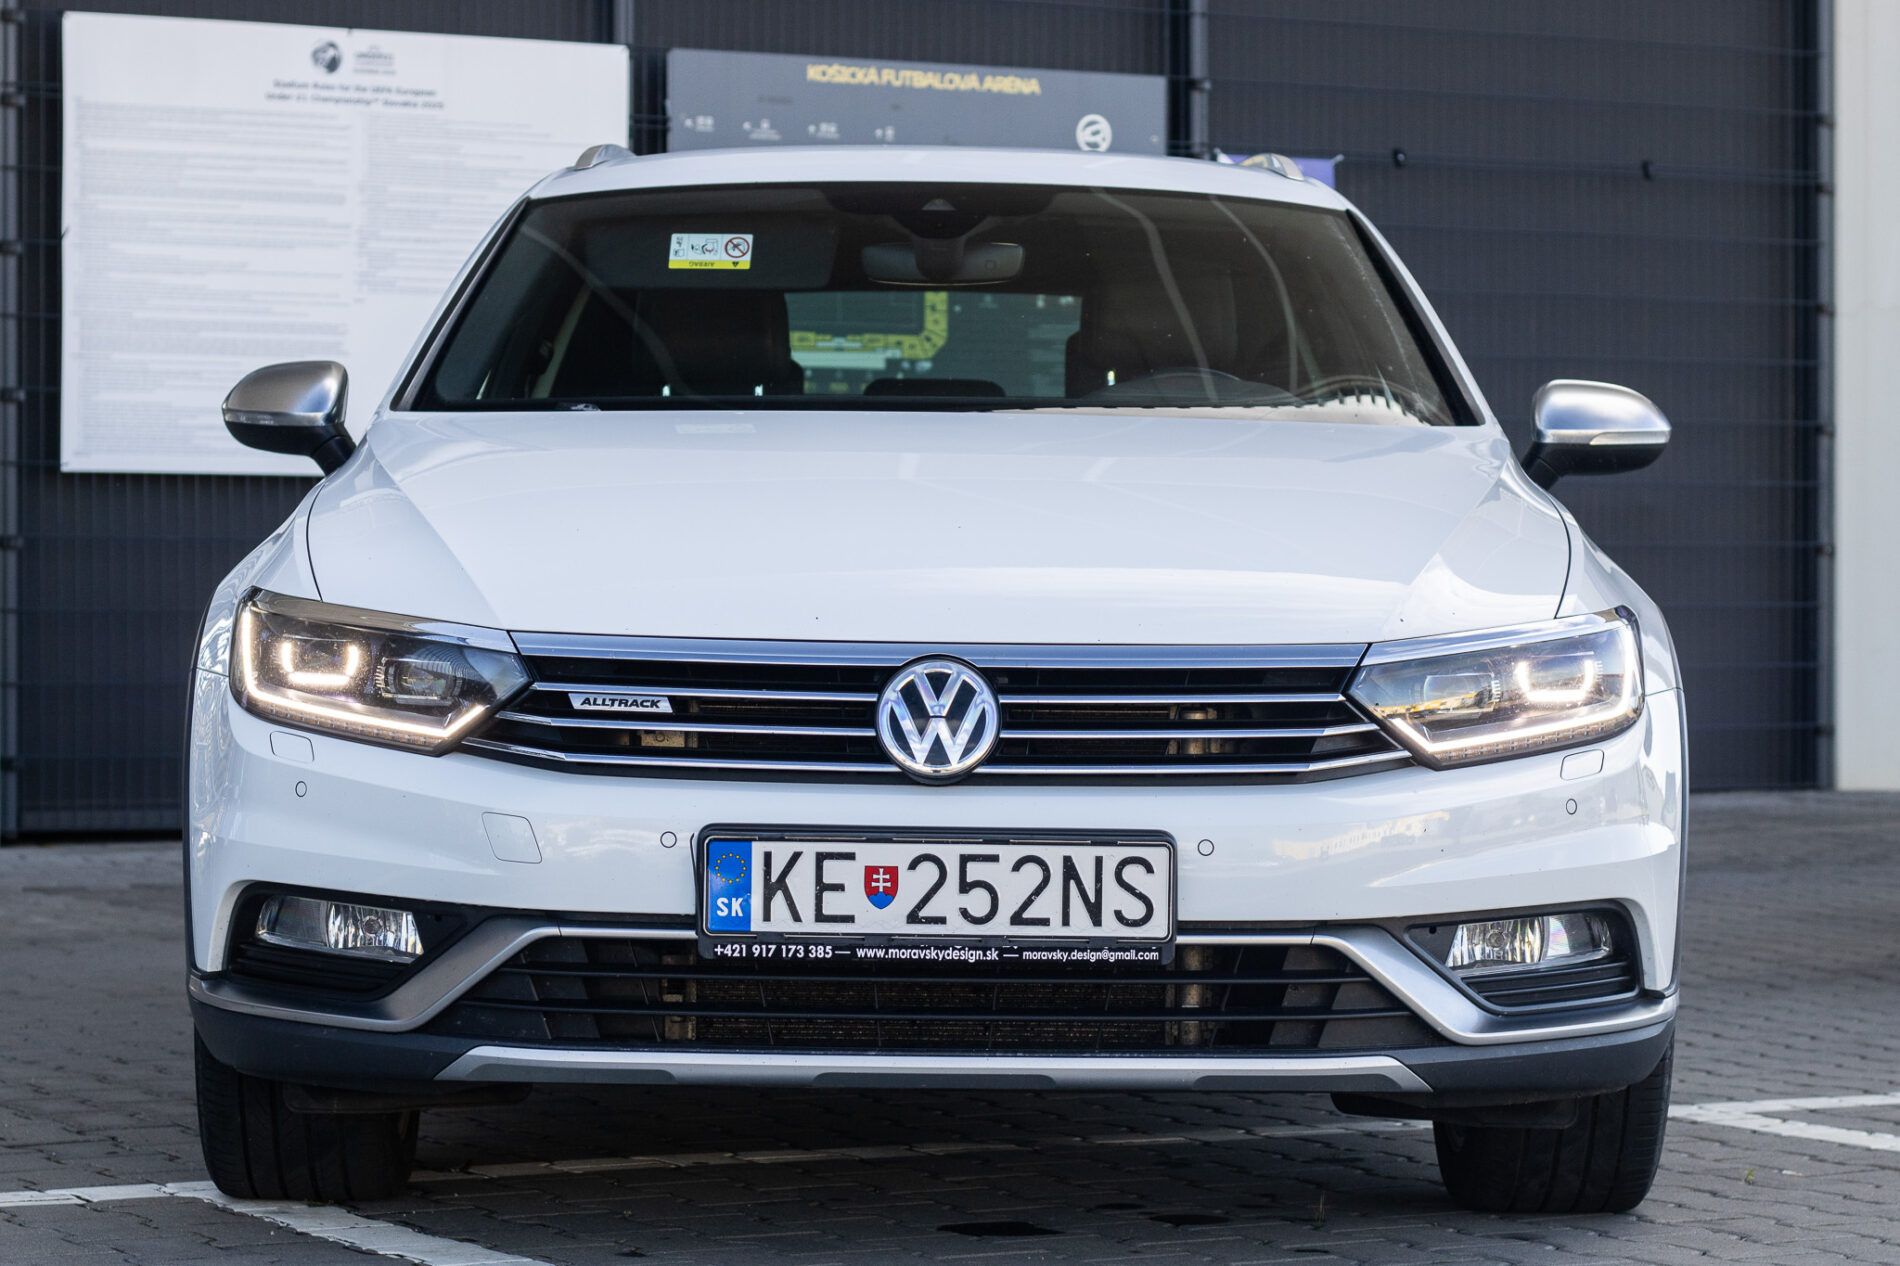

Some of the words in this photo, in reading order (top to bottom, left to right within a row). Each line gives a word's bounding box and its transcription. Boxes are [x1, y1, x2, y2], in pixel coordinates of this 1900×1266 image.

[580, 697, 661, 708] ALLTRACK
[762, 851, 856, 923] KE
[906, 853, 1155, 928] 252NS
[716, 897, 744, 917] SK
[714, 944, 746, 958] +421
[752, 945, 776, 958] 917
[781, 945, 804, 958] 173
[808, 945, 833, 958] 385
[856, 946, 999, 962] www.moravskydesign.sk
[1023, 949, 1159, 962] moravsky.design@gmail.com
